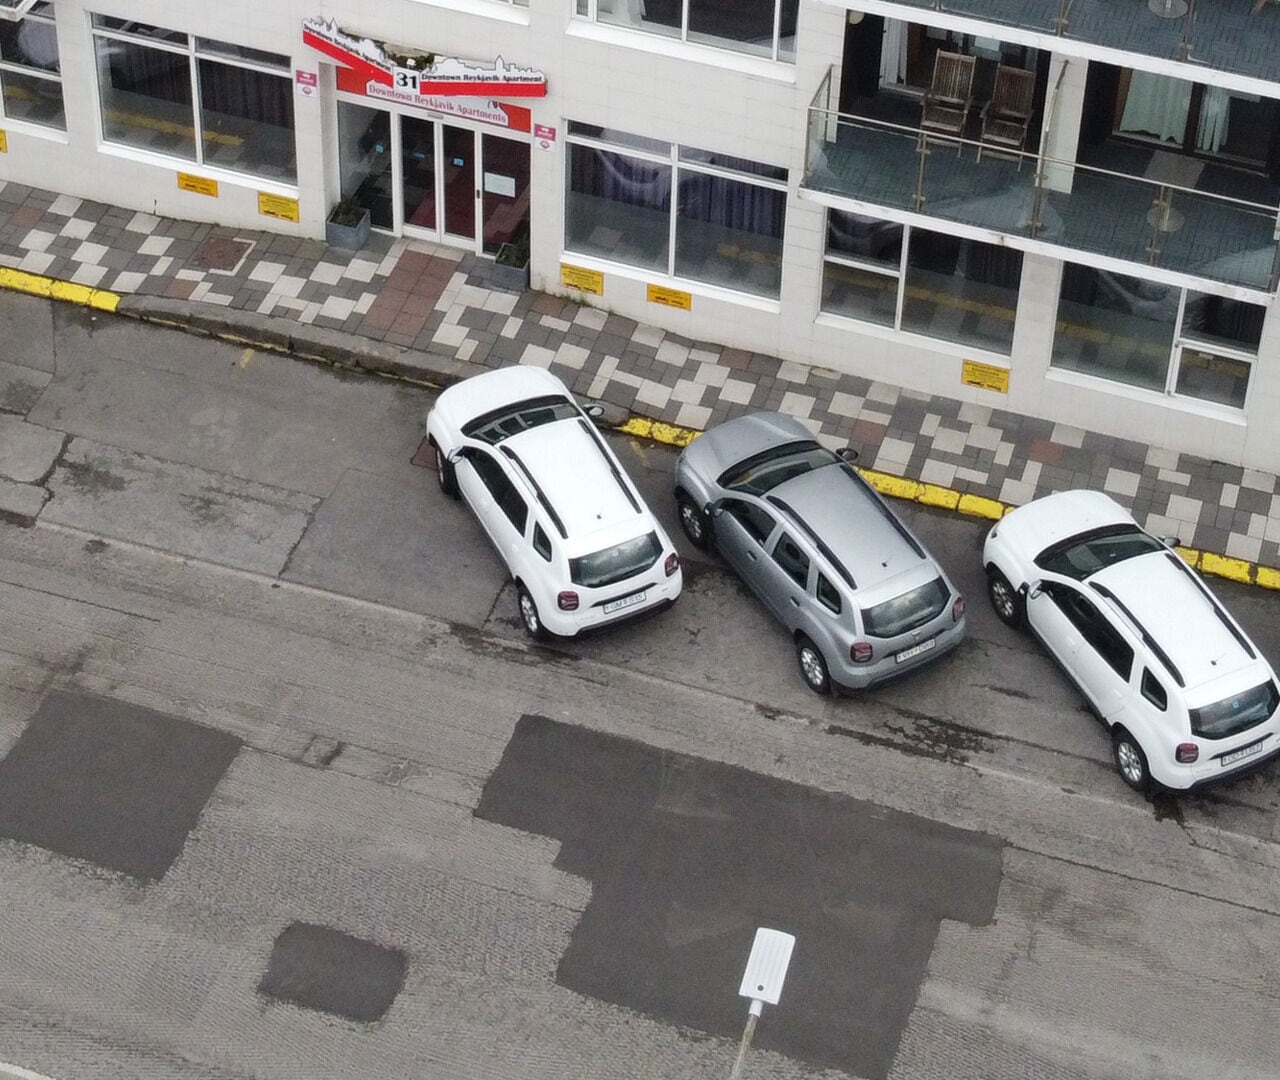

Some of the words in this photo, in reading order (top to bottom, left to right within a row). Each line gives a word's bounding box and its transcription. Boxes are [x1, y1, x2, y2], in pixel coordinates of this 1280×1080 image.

[396, 72, 417, 90] 31
[421, 73, 461, 82] Downtown
[463, 73, 500, 83] Reykjavik
[502, 72, 543, 83] Apartment
[368, 83, 412, 103] Downtown
[414, 95, 455, 112] Reykjavik
[456, 105, 507, 123] Apartments
